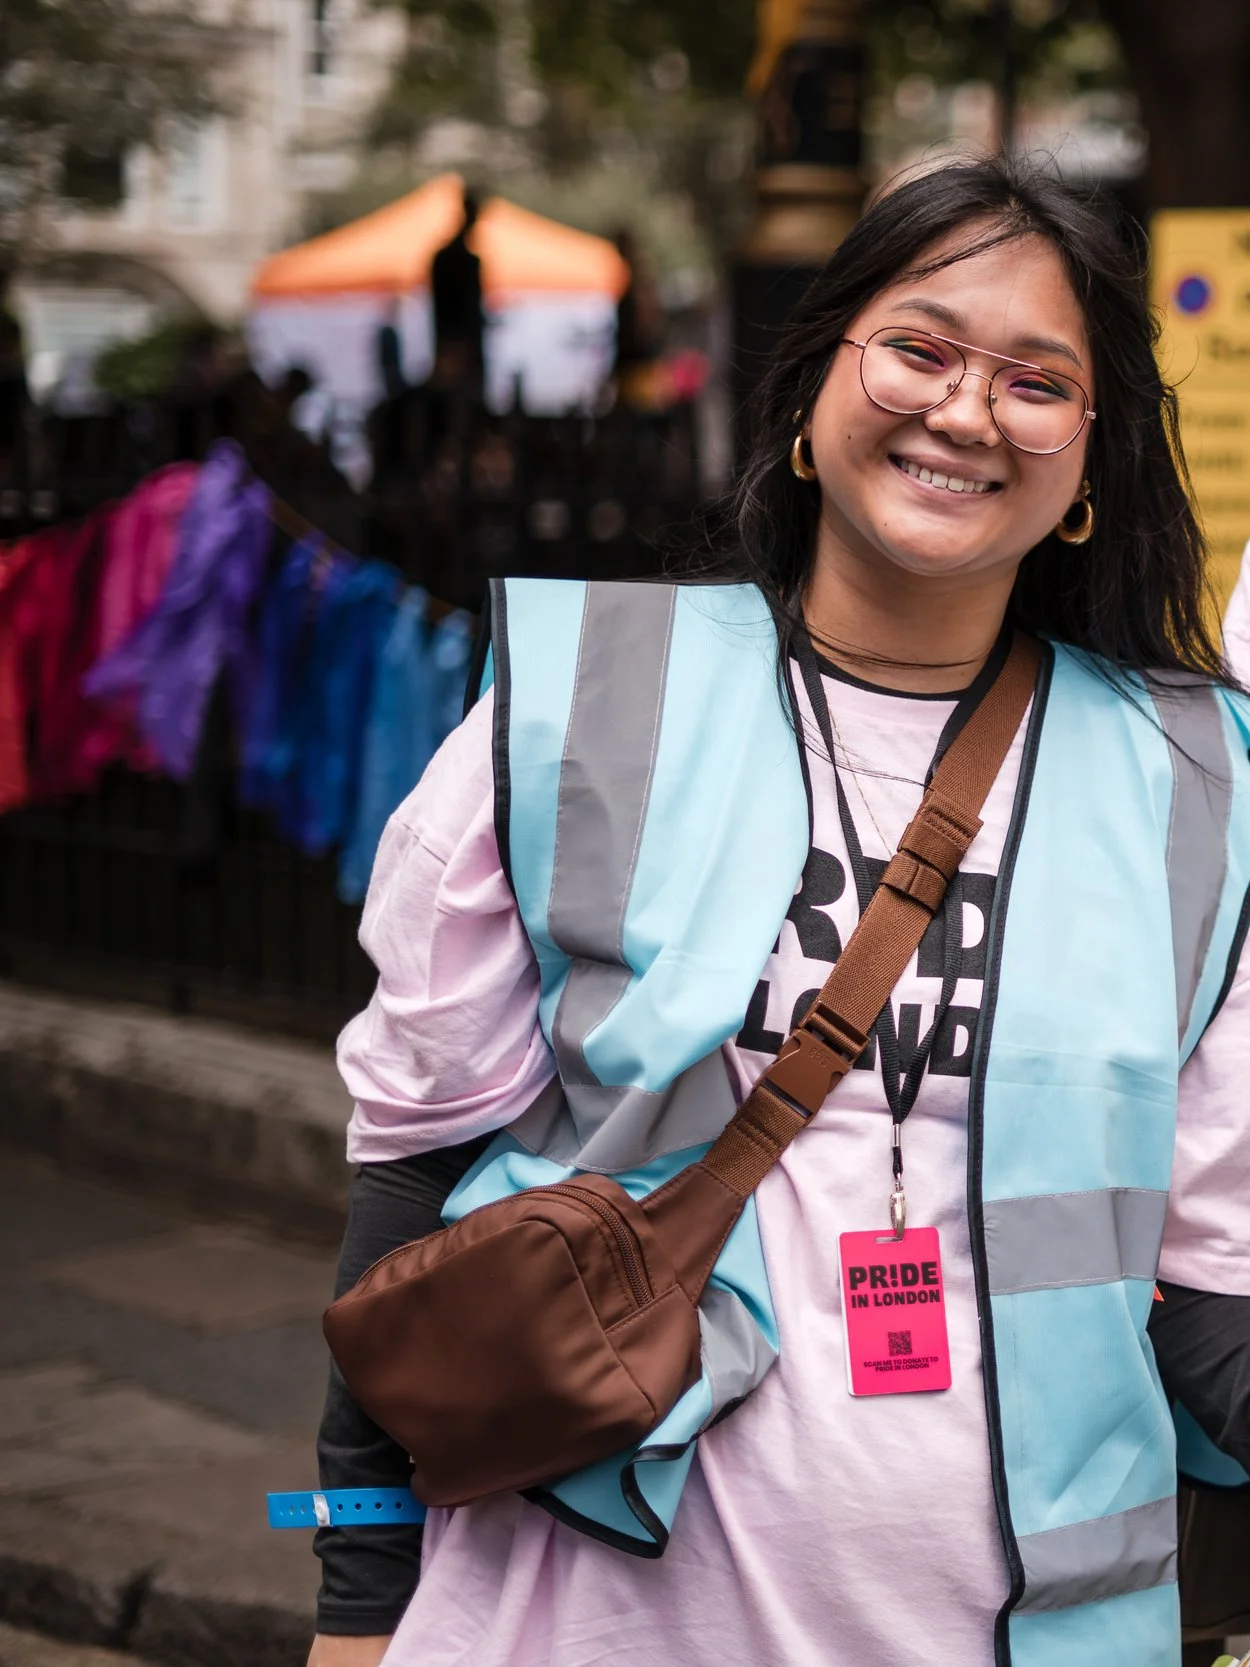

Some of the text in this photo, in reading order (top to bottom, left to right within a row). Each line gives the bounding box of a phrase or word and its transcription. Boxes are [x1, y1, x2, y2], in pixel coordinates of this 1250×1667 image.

[851, 1289, 940, 1308] IN LONDON
[863, 1360, 882, 1368] SCAN
[902, 1362, 930, 1370] LONDON
